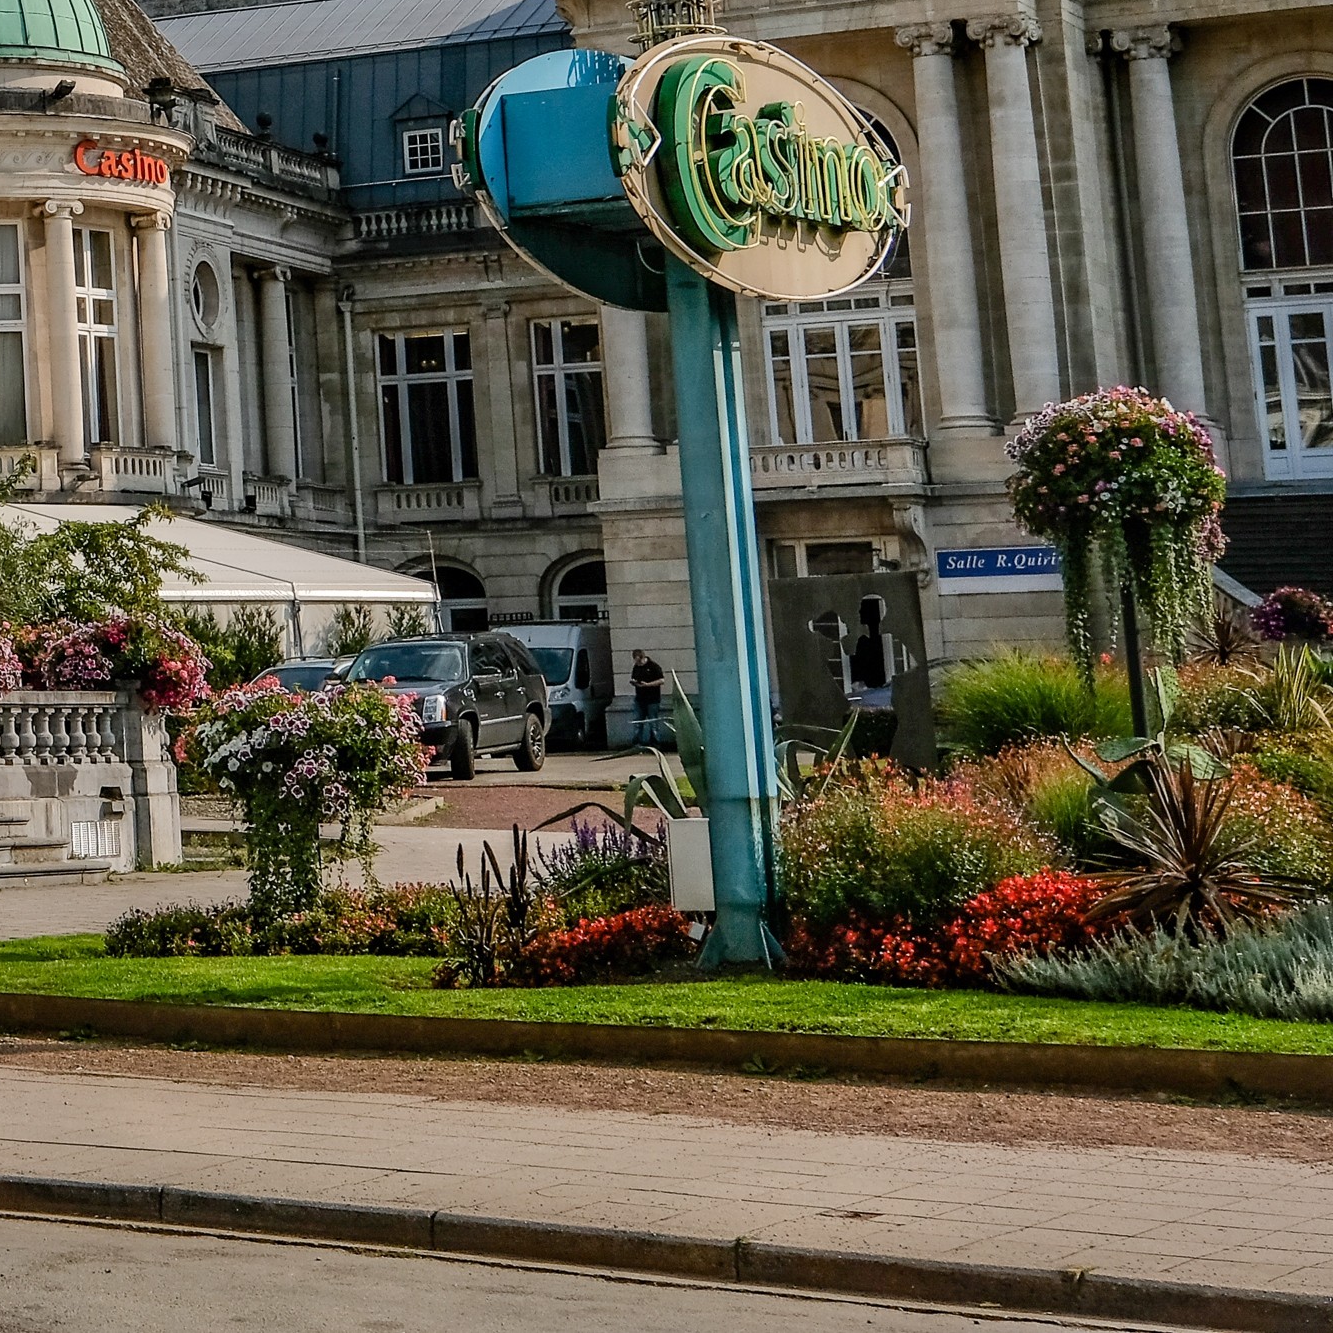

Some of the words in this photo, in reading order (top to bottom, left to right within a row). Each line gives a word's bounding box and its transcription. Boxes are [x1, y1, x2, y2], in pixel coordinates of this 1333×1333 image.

[74, 139, 167, 184] Casino
[656, 56, 889, 251] Casino
[946, 554, 985, 570] Salle
[996, 552, 1062, 569] R.Quiri
